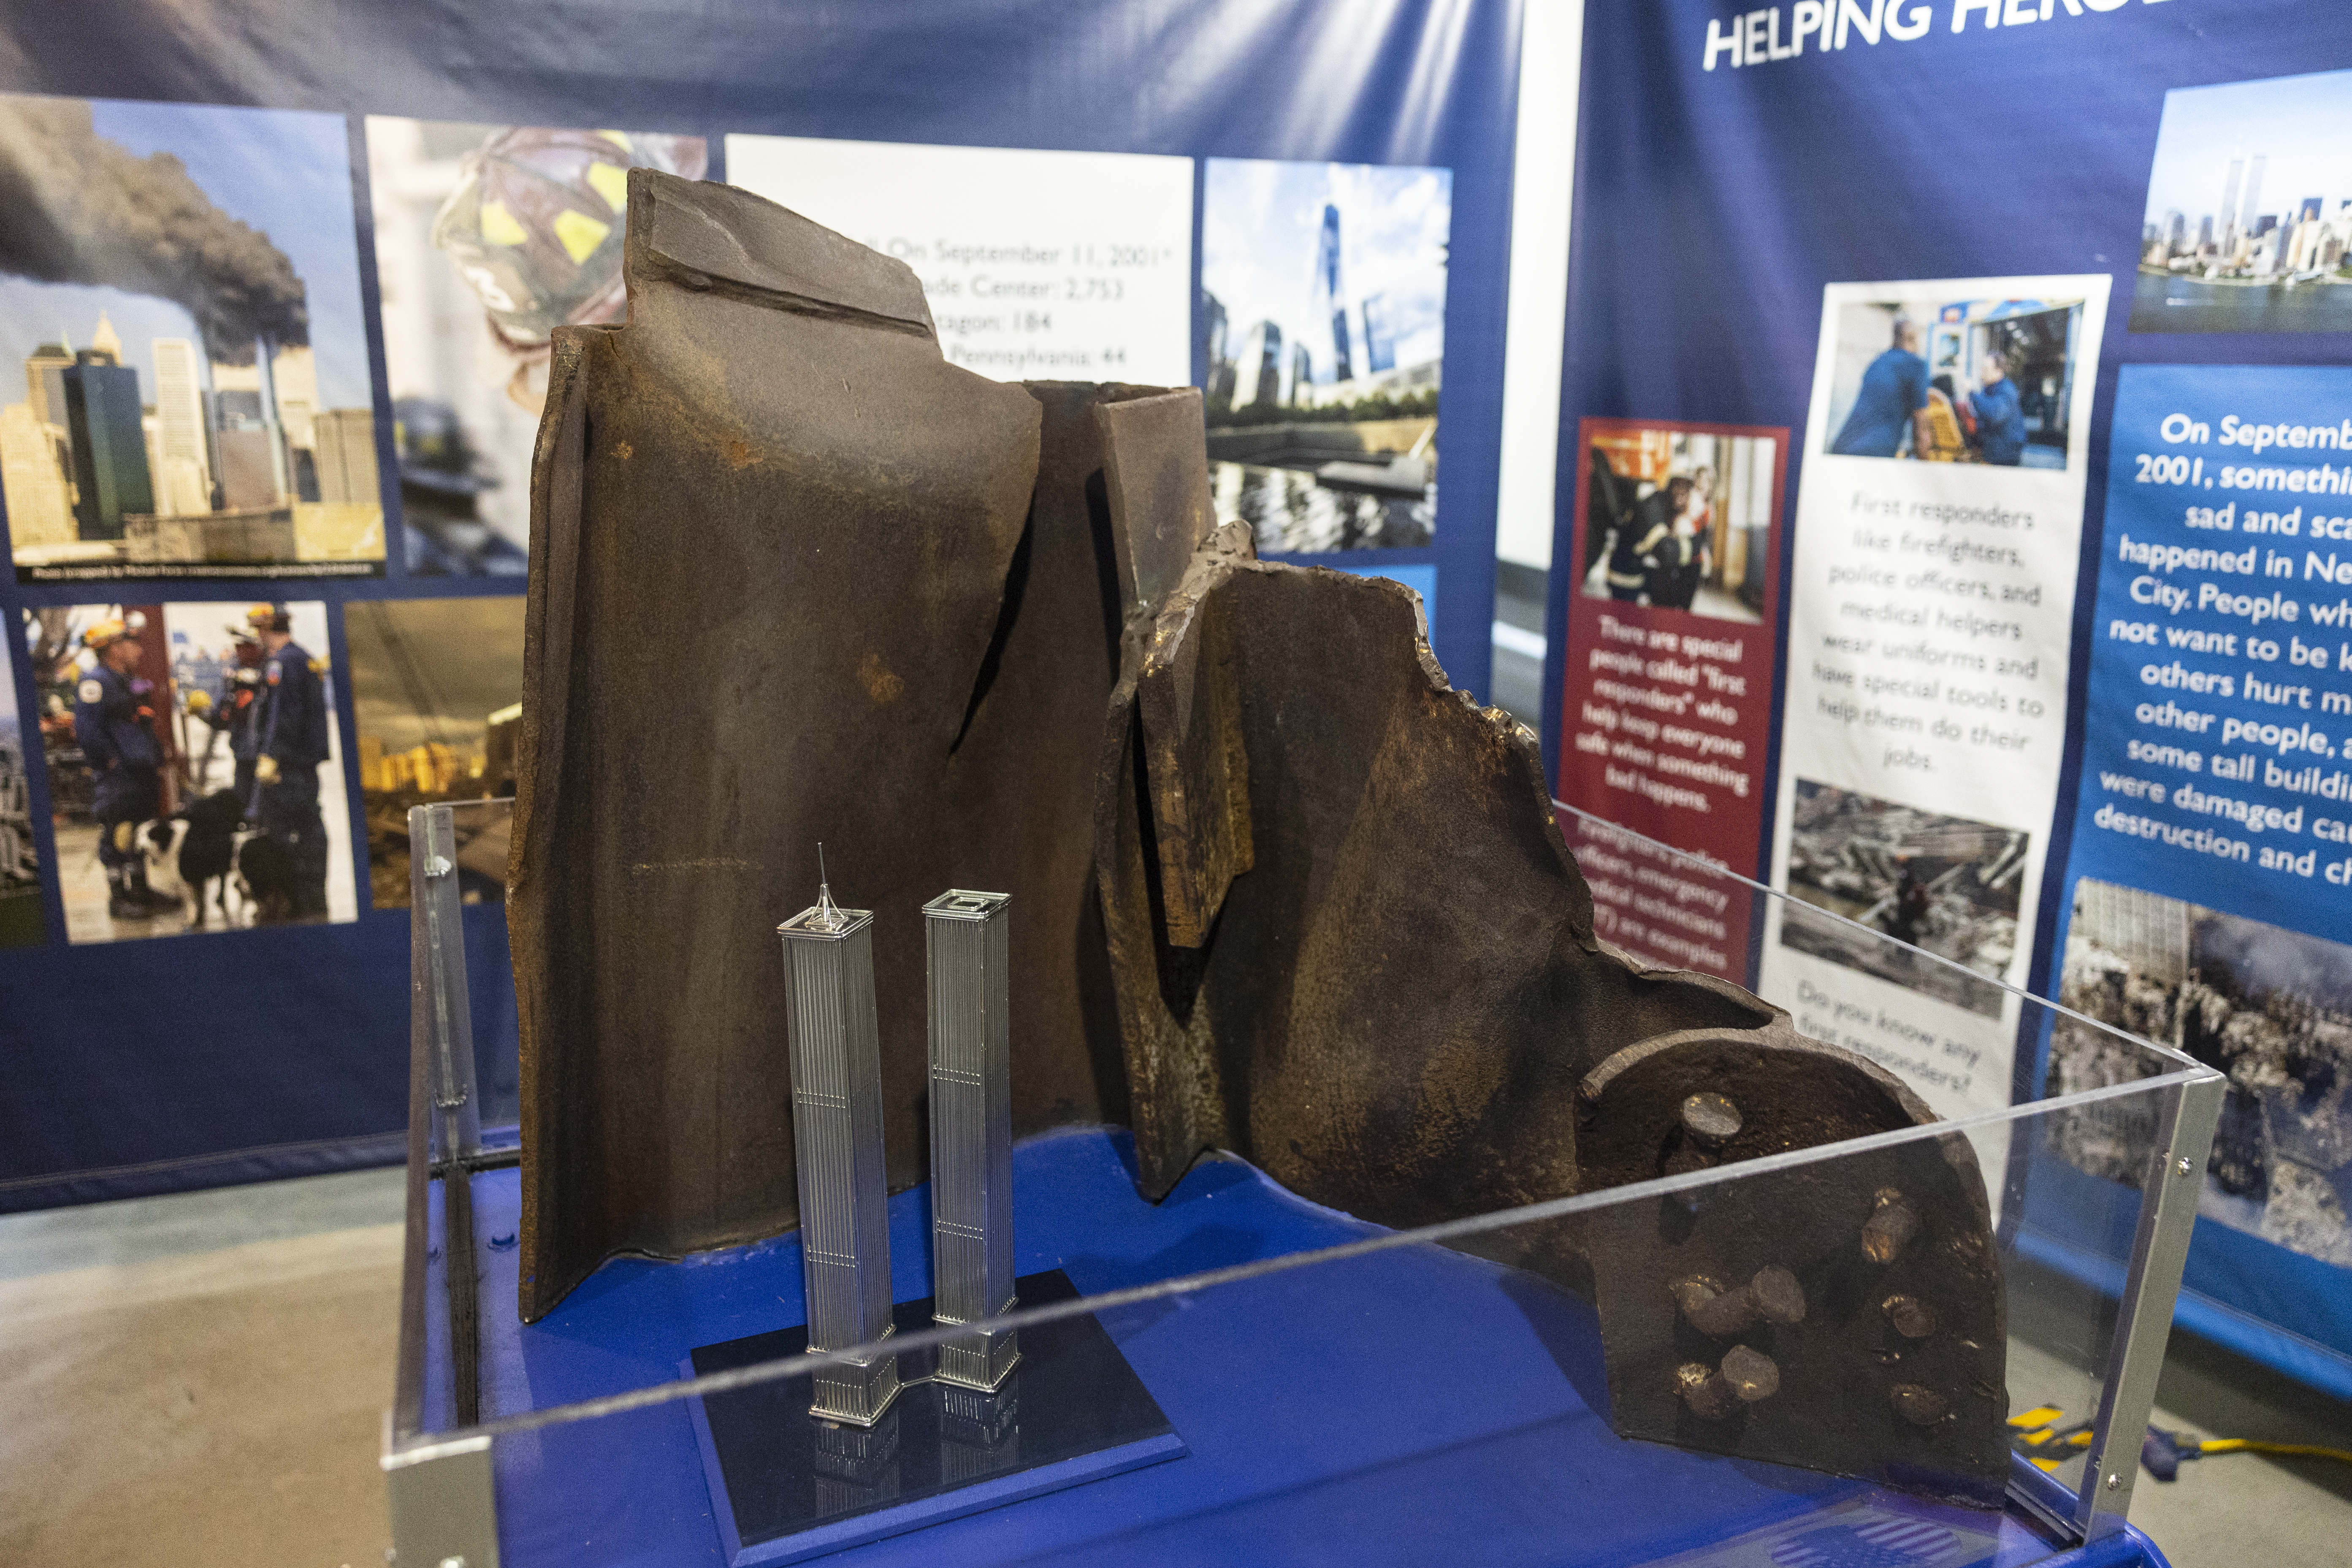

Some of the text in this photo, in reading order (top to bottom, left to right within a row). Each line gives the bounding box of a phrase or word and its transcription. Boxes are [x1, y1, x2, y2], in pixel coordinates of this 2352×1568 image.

[1703, 0, 1931, 71] HELPING
[936, 238, 1059, 268] September
[2160, 413, 2352, 454] On Septemb
[2135, 453, 2352, 496] 2001, somethi
[1909, 502, 2034, 530] responders
[2185, 501, 2235, 531] sad
[2243, 506, 2302, 536] and
[1900, 532, 2026, 567] firefighters,
[2119, 533, 2352, 585] happened in Ne
[1828, 564, 2042, 607] police officers, and
[2130, 575, 2192, 615] City.
[2198, 582, 2299, 626] People
[1840, 601, 2022, 640] medical helpers
[2110, 619, 2159, 645] not
[2165, 627, 2238, 656] want
[2246, 637, 2279, 661] to
[2290, 635, 2329, 669] be
[1822, 634, 2039, 680] wear uniforms and
[1812, 661, 2044, 719] have special tools to
[2140, 661, 2235, 698] others
[2243, 671, 2312, 710] hurt
[1817, 695, 2030, 752] help them do their
[2135, 701, 2216, 733] other
[2222, 717, 2336, 760] people,
[2127, 739, 2352, 802] some tall buildi
[2100, 771, 2352, 844] were damaged ca
[2094, 804, 2251, 862] destruction
[2258, 846, 2317, 877] and
